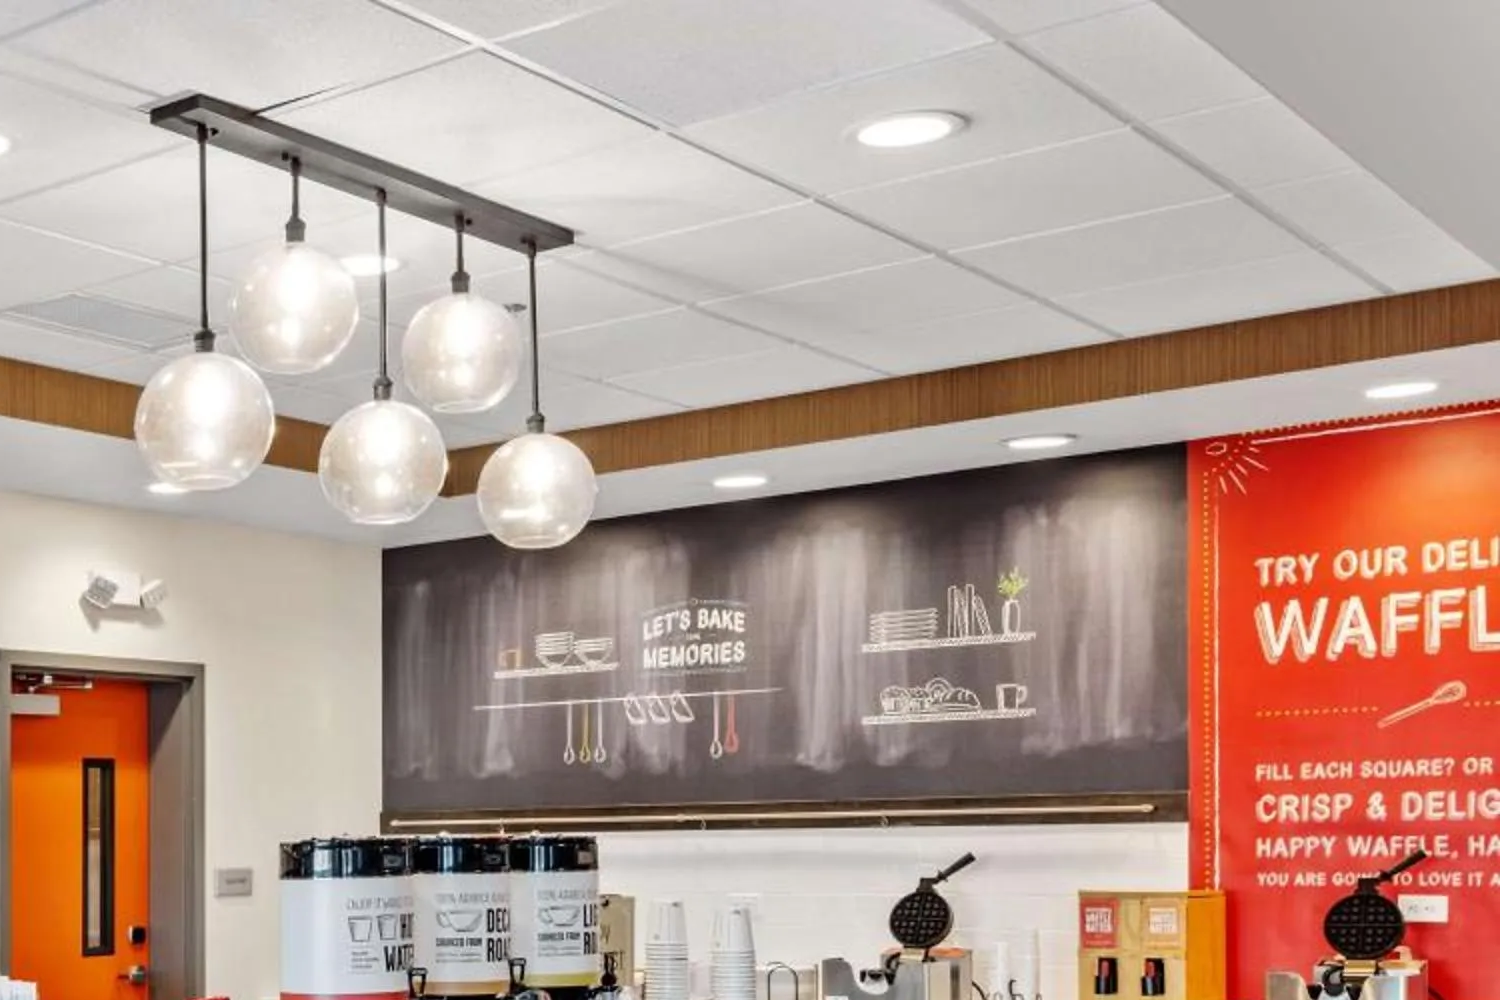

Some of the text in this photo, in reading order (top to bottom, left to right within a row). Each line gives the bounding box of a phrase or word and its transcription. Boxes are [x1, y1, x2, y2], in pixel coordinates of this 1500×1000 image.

[1255, 553, 1320, 587] TRY
[1333, 546, 1408, 580] OUR
[643, 607, 745, 641] LET'S BAKE
[643, 640, 745, 669] MEMORIES
[1255, 757, 1493, 782] FILL EACH SQUARE? OR
[1256, 792, 1353, 822] CRISP
[1366, 791, 1388, 821] &
[1256, 835, 1337, 858] HAPPY
[1257, 872, 1288, 887] YOU
[1294, 872, 1326, 887] ARE
[1418, 872, 1462, 887] LOVE
[1468, 871, 1484, 887] IT
